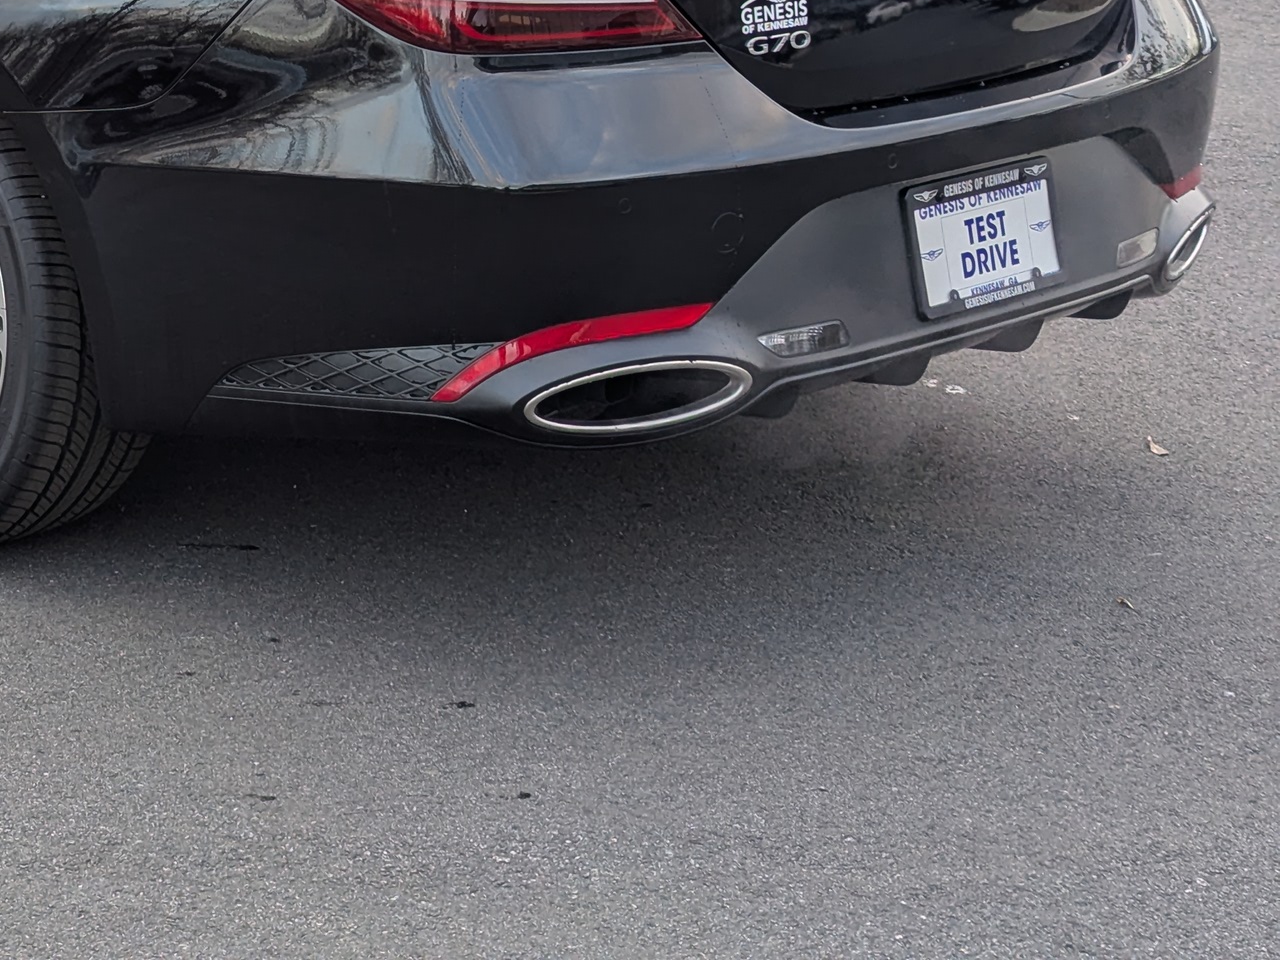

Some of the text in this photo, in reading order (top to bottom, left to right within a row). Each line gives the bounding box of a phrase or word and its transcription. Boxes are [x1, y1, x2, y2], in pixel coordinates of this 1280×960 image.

[740, 0, 808, 25] GENESIS
[741, 16, 808, 35] OF KENNESAW
[745, 30, 812, 56] G70
[943, 169, 1020, 198] GENESIS OF KENNESAW
[919, 180, 1042, 220] GENESIS OF KENNESAW
[963, 210, 1006, 245] TEST
[961, 238, 1021, 279] DRIVE
[965, 281, 1036, 309] GENESISOFKENNESAW.COM
